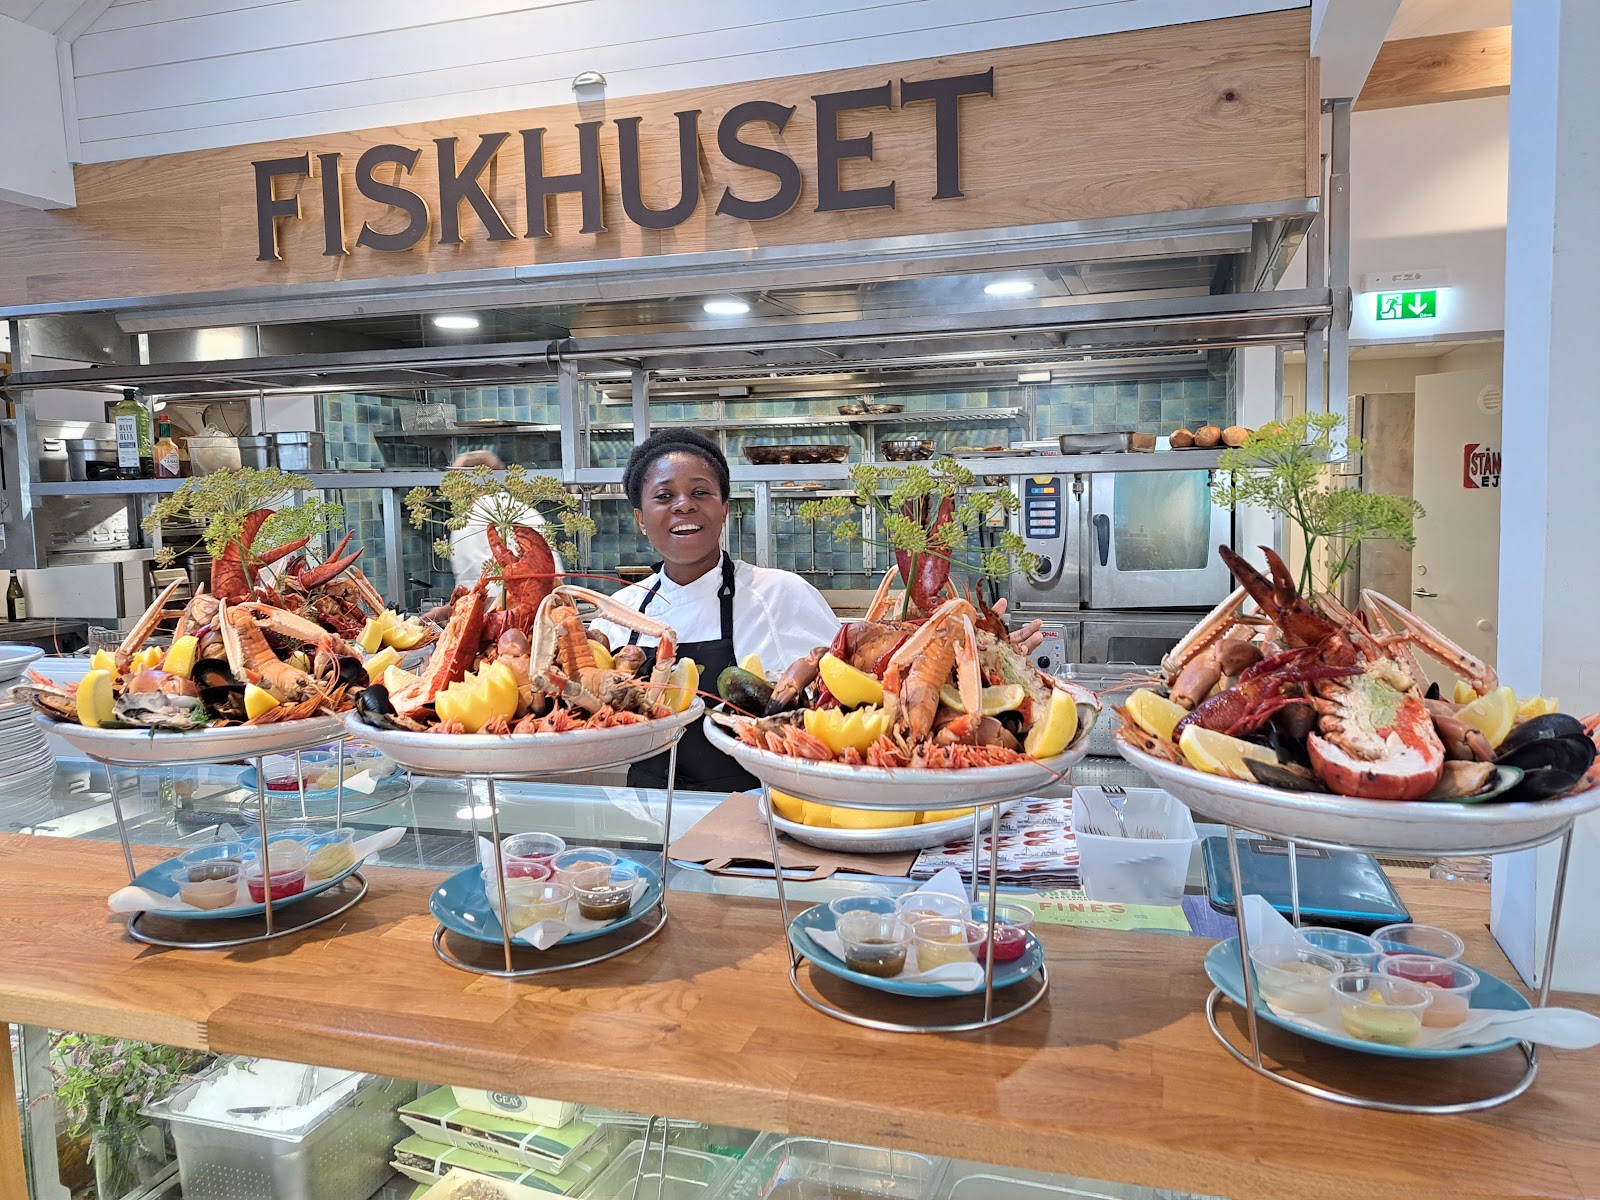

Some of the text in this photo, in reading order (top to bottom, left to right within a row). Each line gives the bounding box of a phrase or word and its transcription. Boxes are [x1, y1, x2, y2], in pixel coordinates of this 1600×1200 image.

[251, 66, 994, 261] FISKHUSET
[1482, 476, 1500, 487] EJ
[1039, 902, 1126, 914] FINES
[494, 1092, 519, 1107] GEAY
